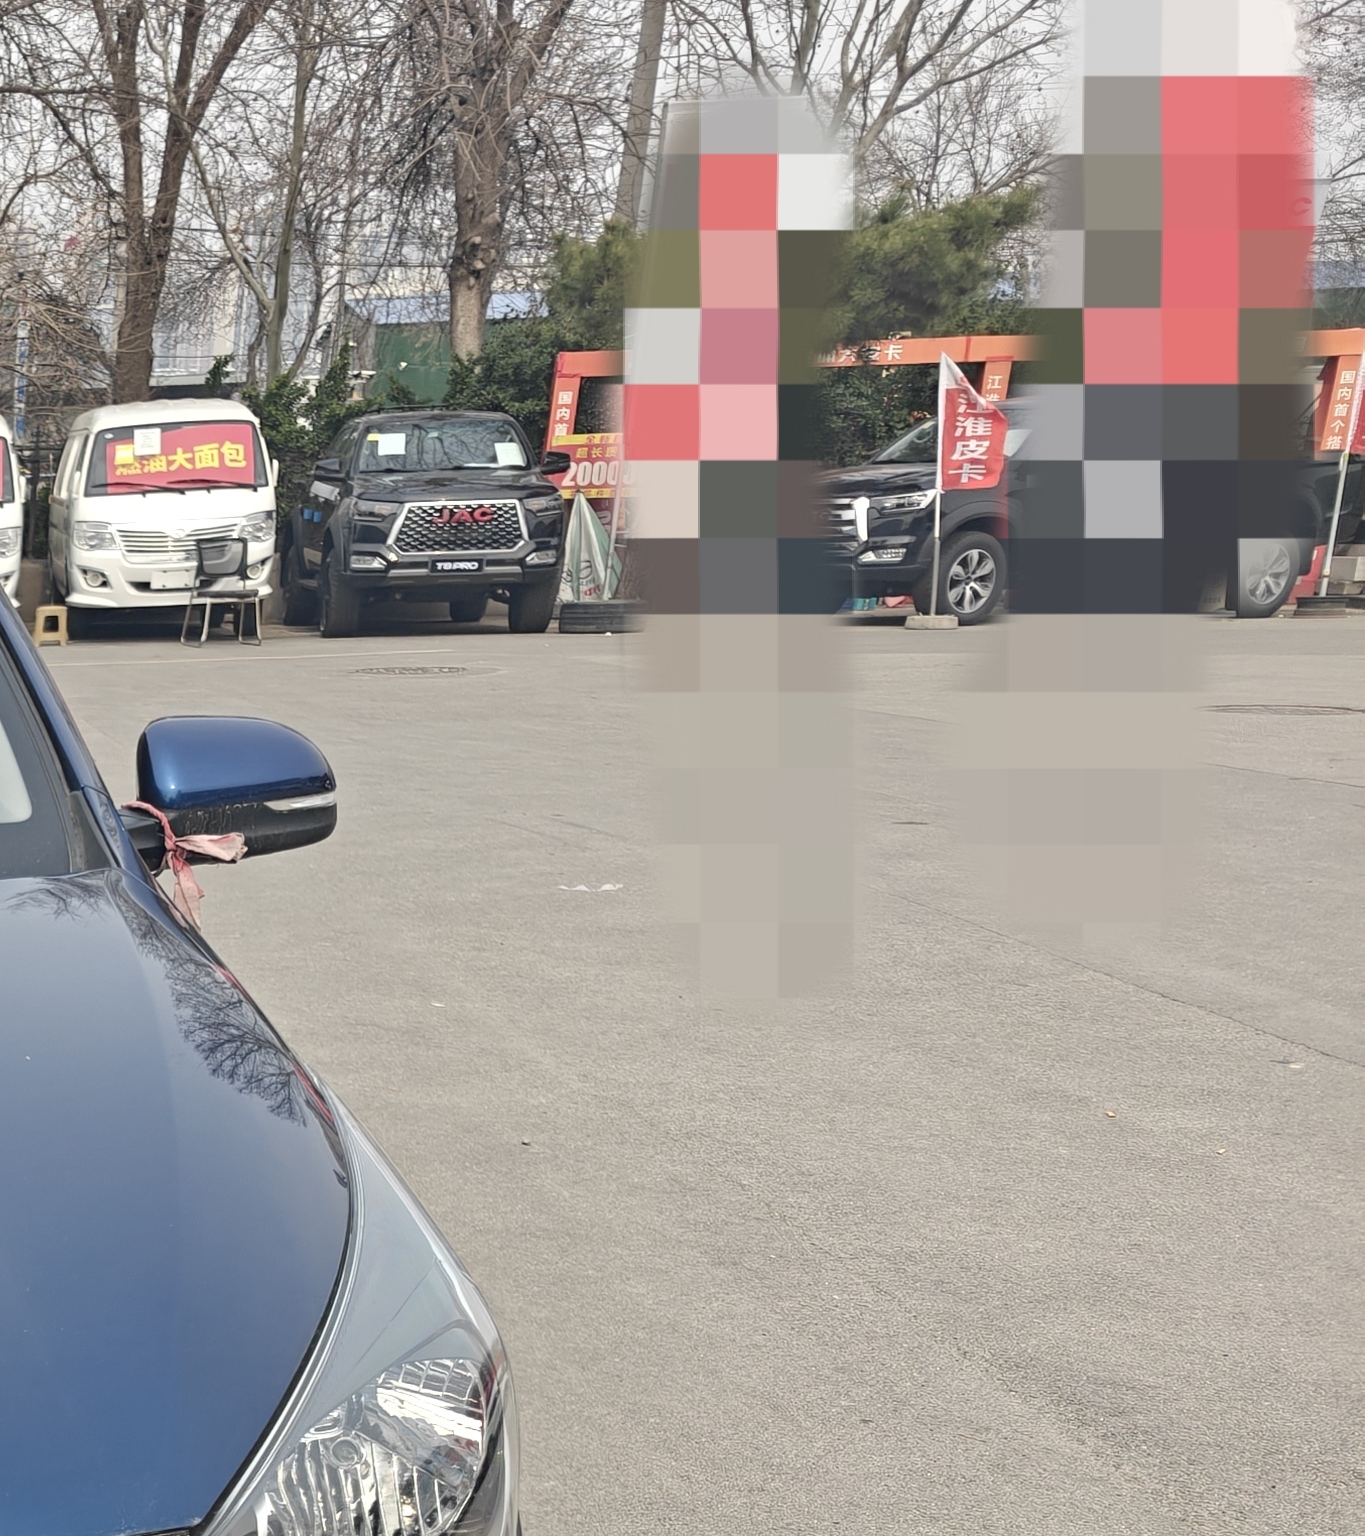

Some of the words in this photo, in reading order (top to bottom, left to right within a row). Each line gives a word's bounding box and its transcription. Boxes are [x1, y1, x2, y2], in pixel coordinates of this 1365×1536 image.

[948, 393, 993, 483] 江淮皮卡
[433, 506, 494, 525] JAC
